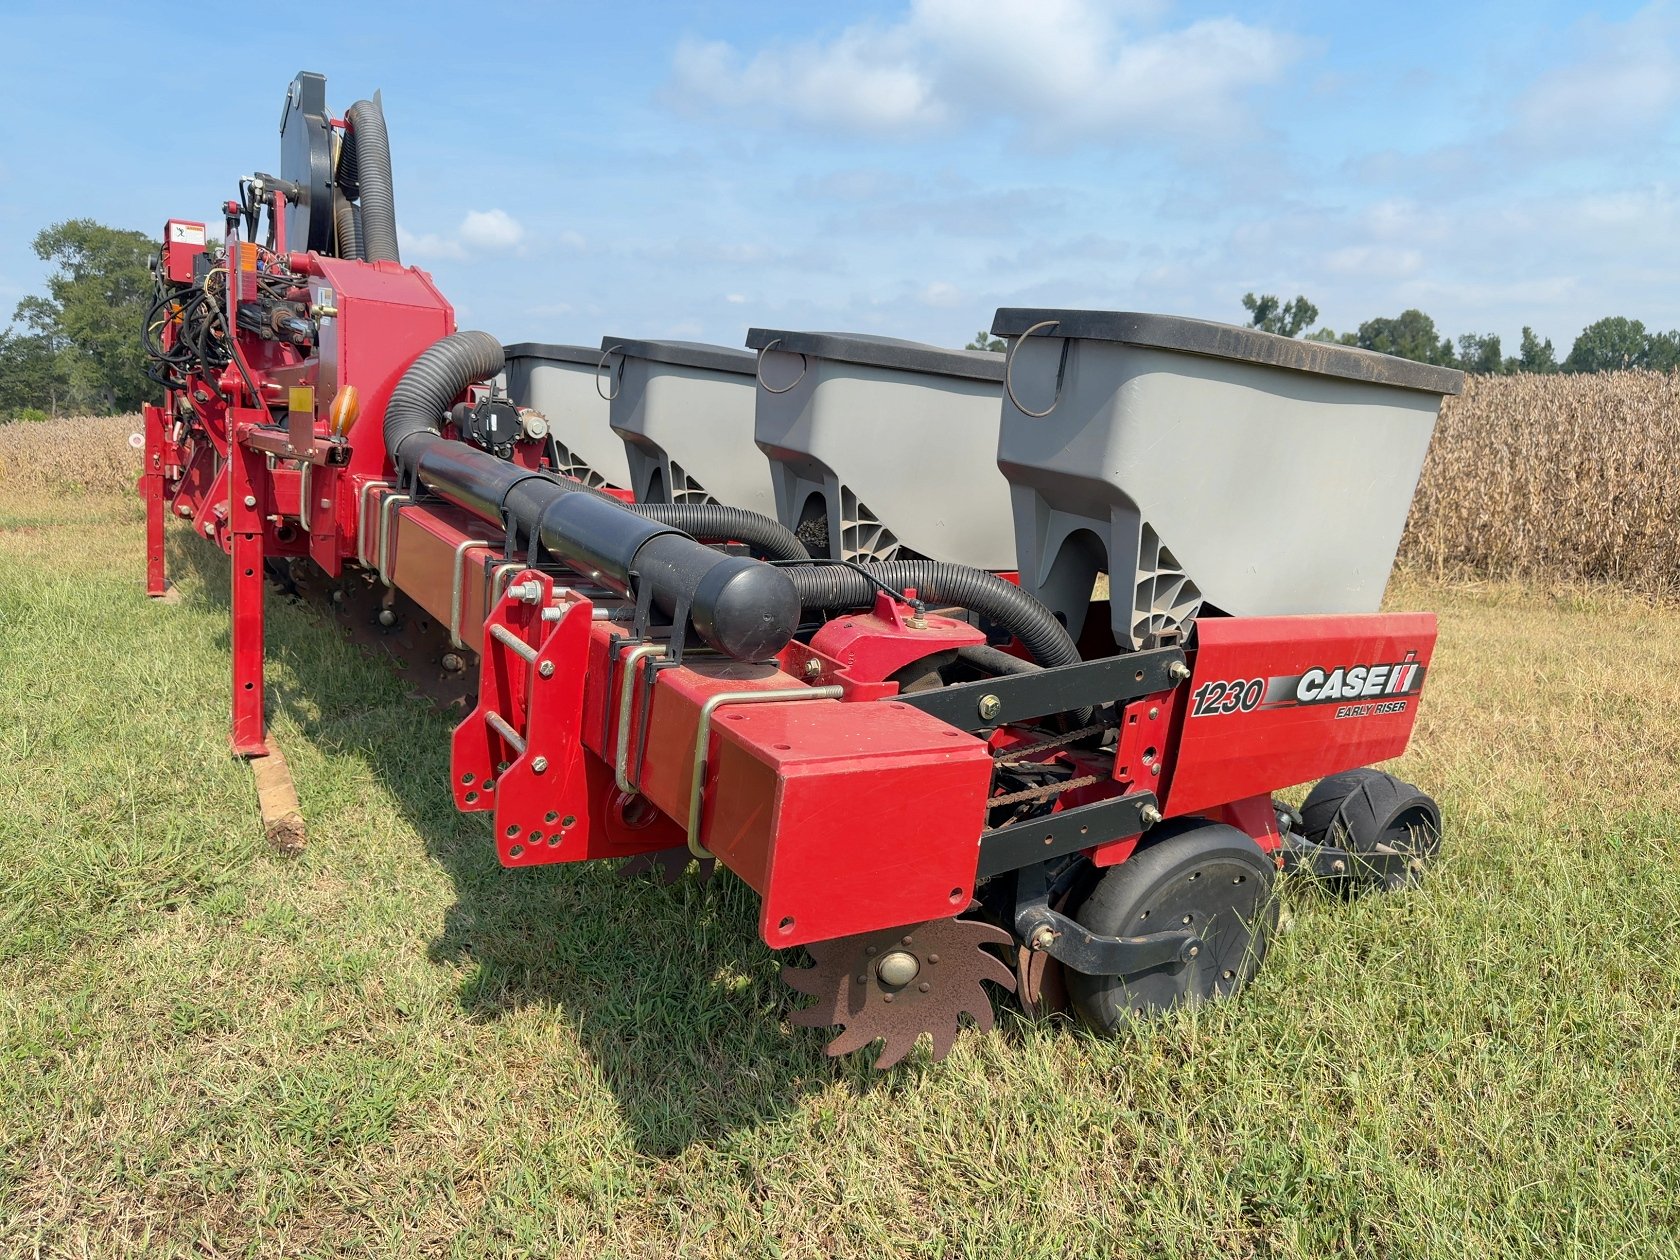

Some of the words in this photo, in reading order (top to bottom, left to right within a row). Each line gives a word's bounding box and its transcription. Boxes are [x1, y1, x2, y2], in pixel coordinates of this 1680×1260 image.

[1191, 678, 1264, 717] 1230
[1335, 704, 1373, 719] EARLY
[1374, 701, 1407, 714] RISER
